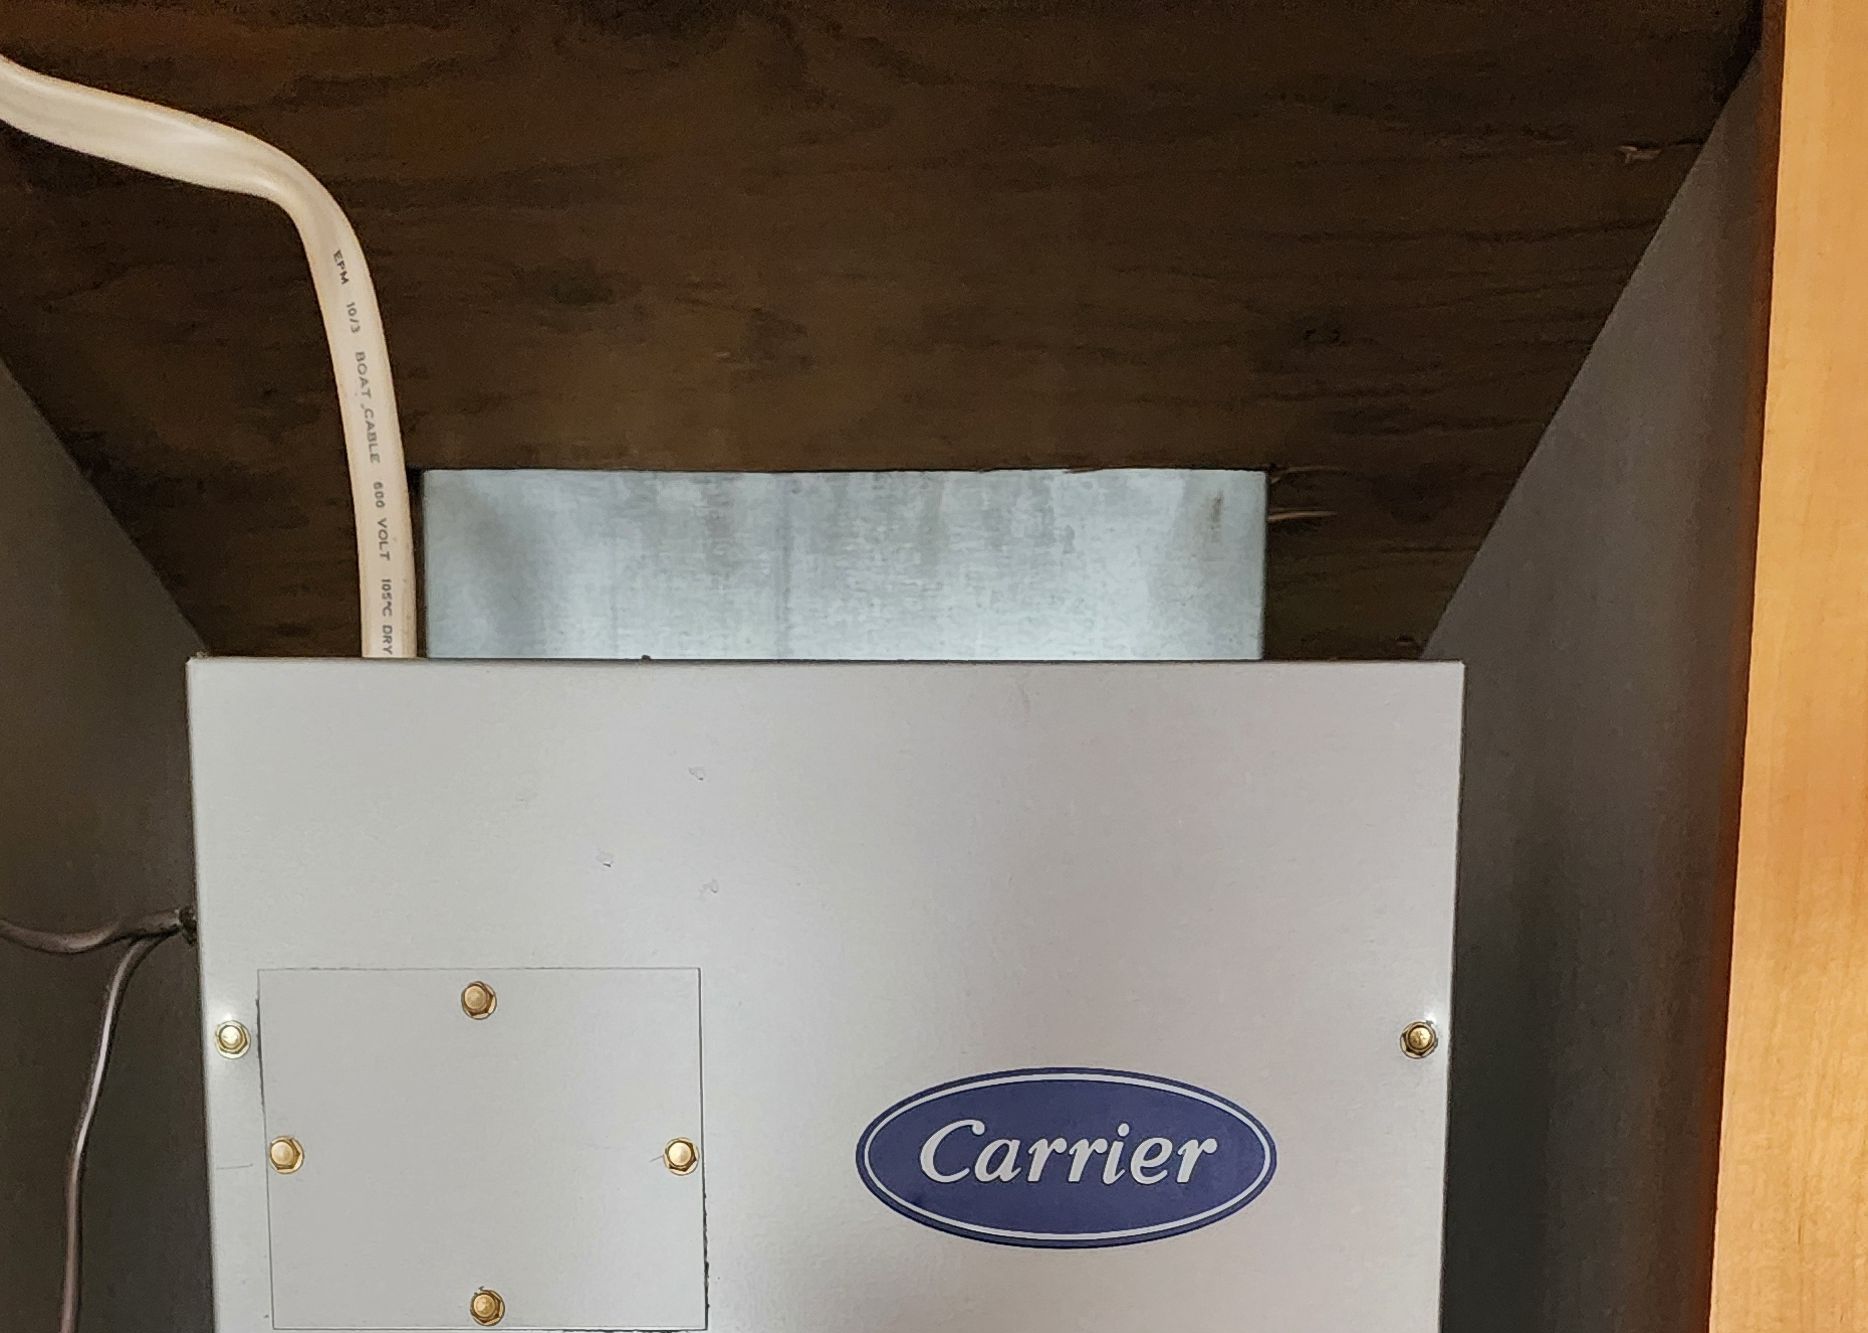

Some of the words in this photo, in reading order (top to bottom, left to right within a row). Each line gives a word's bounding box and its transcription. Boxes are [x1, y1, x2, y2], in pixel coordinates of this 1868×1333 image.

[332, 248, 350, 286] EPM
[344, 300, 361, 335] 10/3
[354, 350, 374, 400] BOAT
[362, 406, 381, 464] CABLE
[372, 480, 386, 510] 600
[376, 517, 391, 562] VOLT
[381, 624, 394, 656] DRY
[919, 1118, 1218, 1186] Carrier
